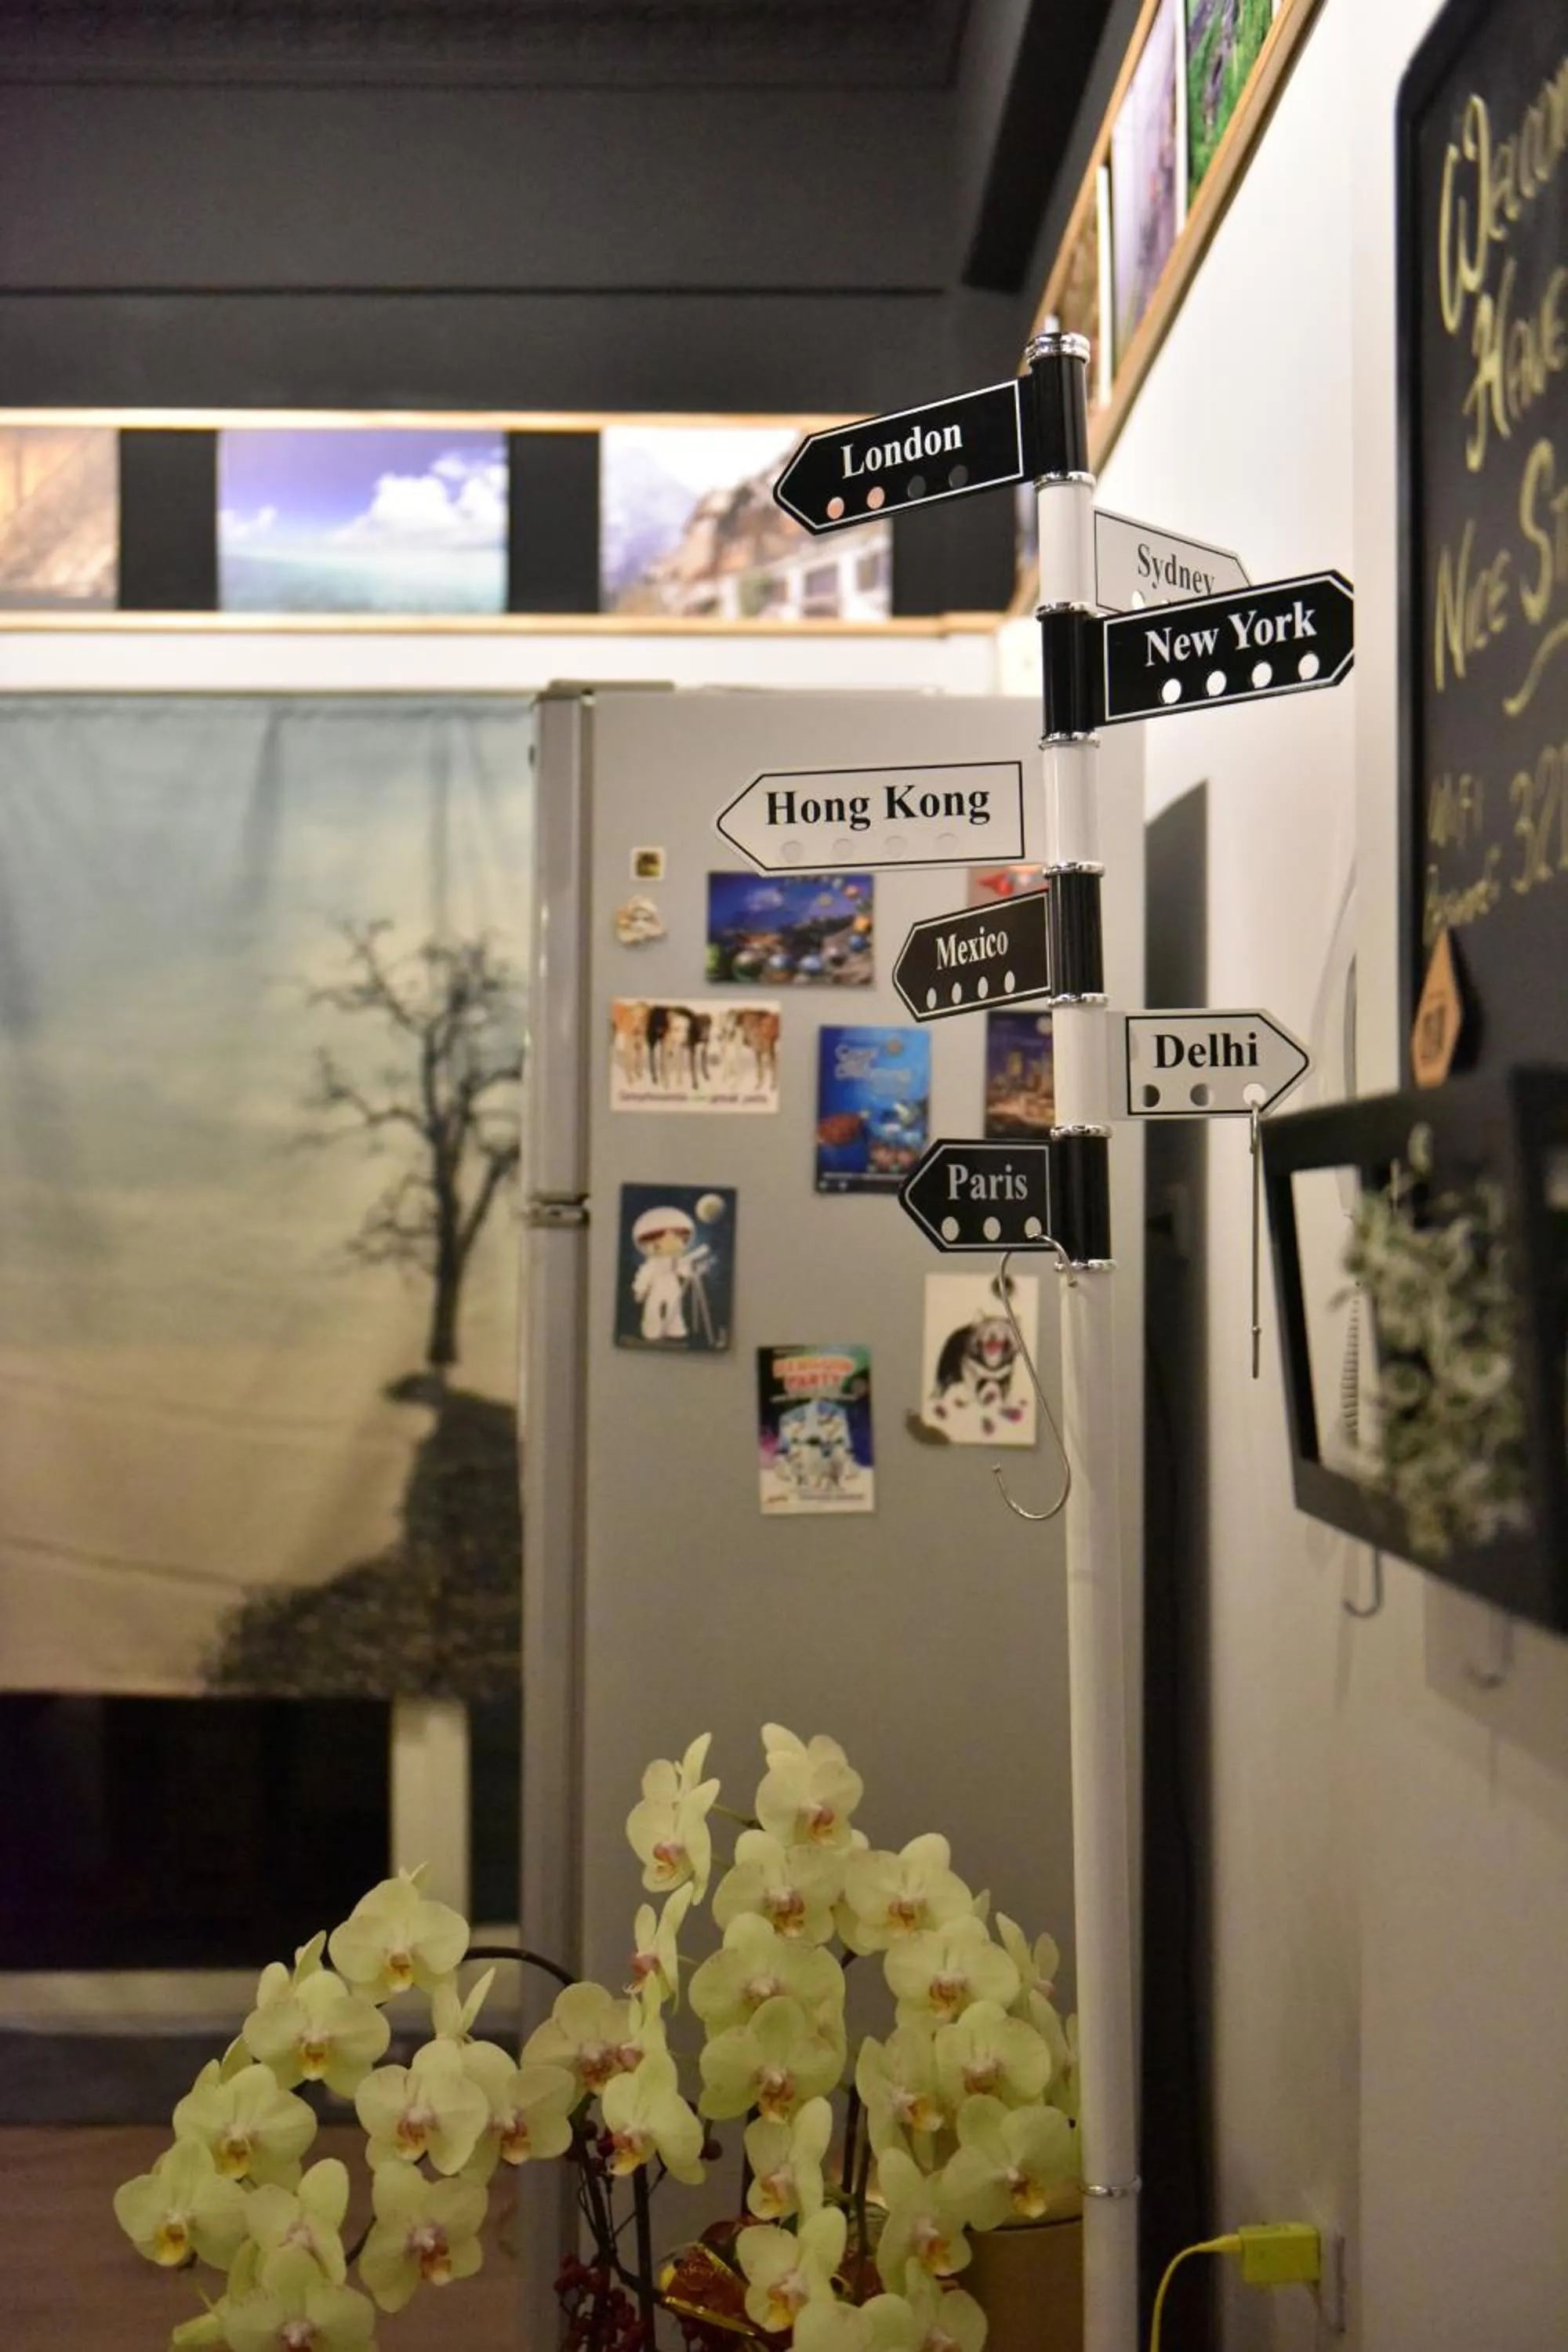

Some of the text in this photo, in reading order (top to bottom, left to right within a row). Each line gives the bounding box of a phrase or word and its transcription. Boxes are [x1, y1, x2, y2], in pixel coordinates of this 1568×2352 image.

[840, 424, 964, 479] London
[1137, 543, 1215, 595] Sydney
[1145, 601, 1318, 666] New York
[766, 785, 991, 832] Hong Kong
[935, 926, 1009, 970] Mexico
[1154, 1032, 1259, 1069] Delhi
[947, 1163, 1029, 1200] Paris
